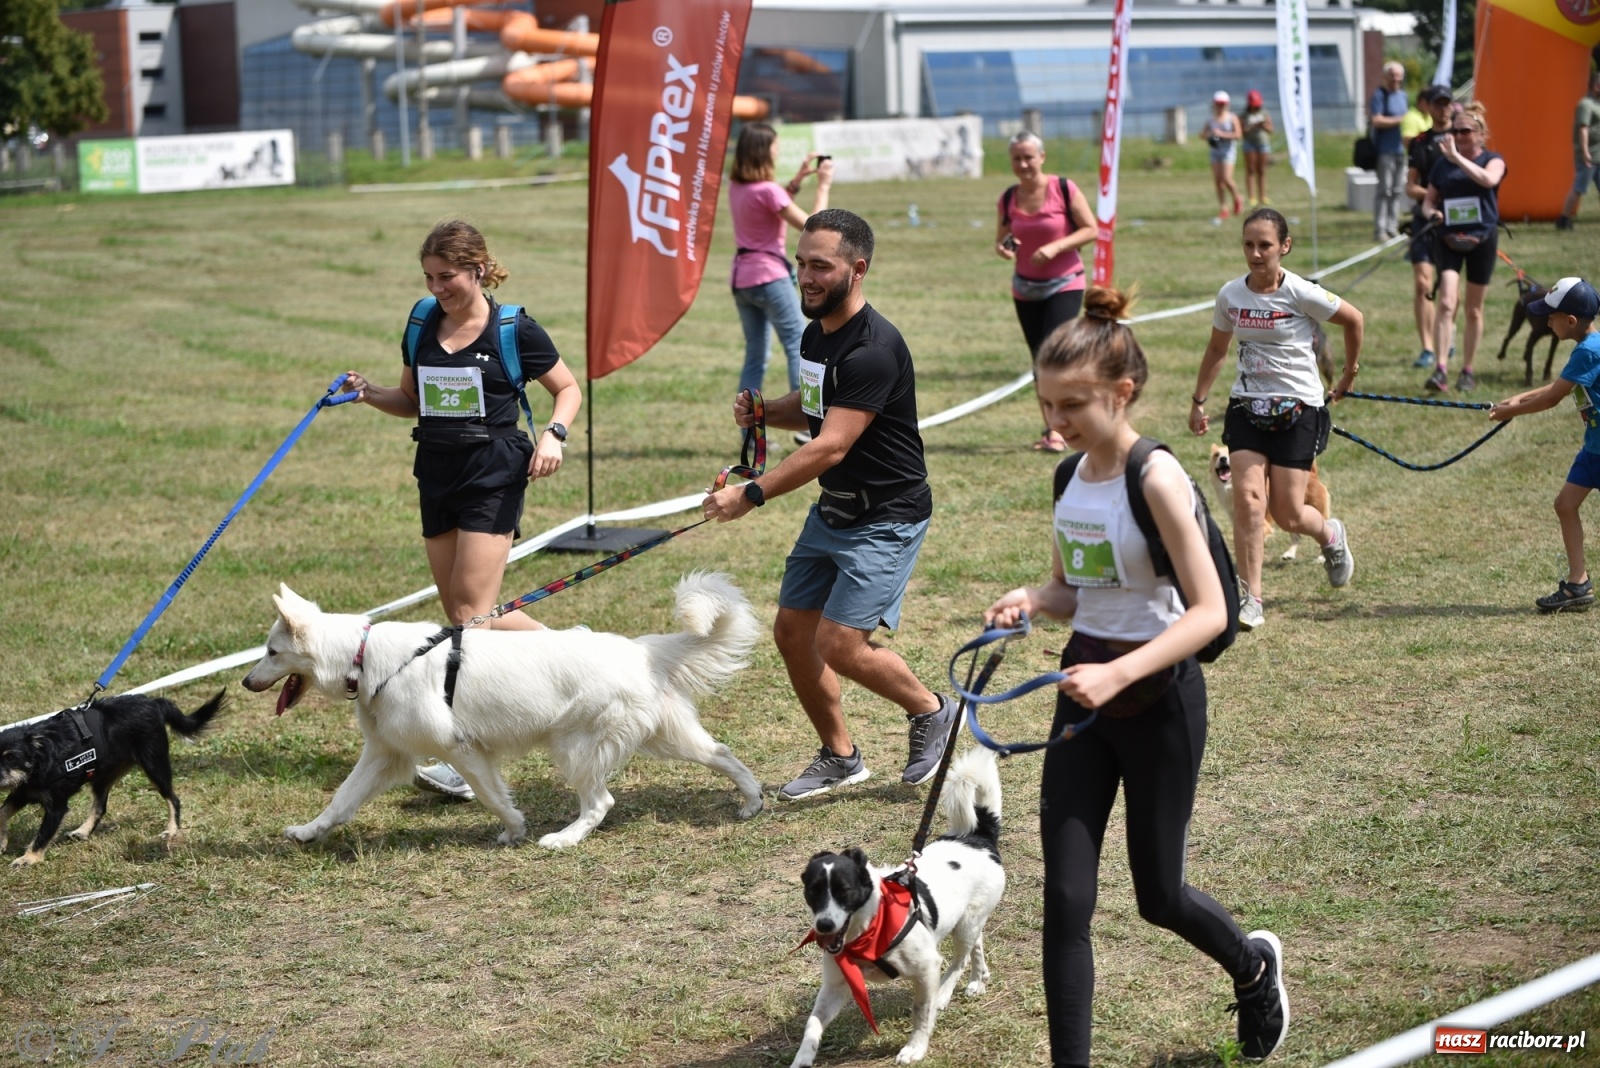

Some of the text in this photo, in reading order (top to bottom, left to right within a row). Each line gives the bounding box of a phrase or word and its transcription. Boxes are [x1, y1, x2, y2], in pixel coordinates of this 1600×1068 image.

[716, 10, 731, 46] kotów
[711, 51, 724, 83] psów
[698, 92, 716, 151] kleszczom
[686, 202, 700, 262] przeciwko
[1239, 318, 1274, 329] GRANIC
[1249, 310, 1271, 319] BIEG
[440, 393, 460, 407] 26
[1071, 548, 1084, 570] 8
